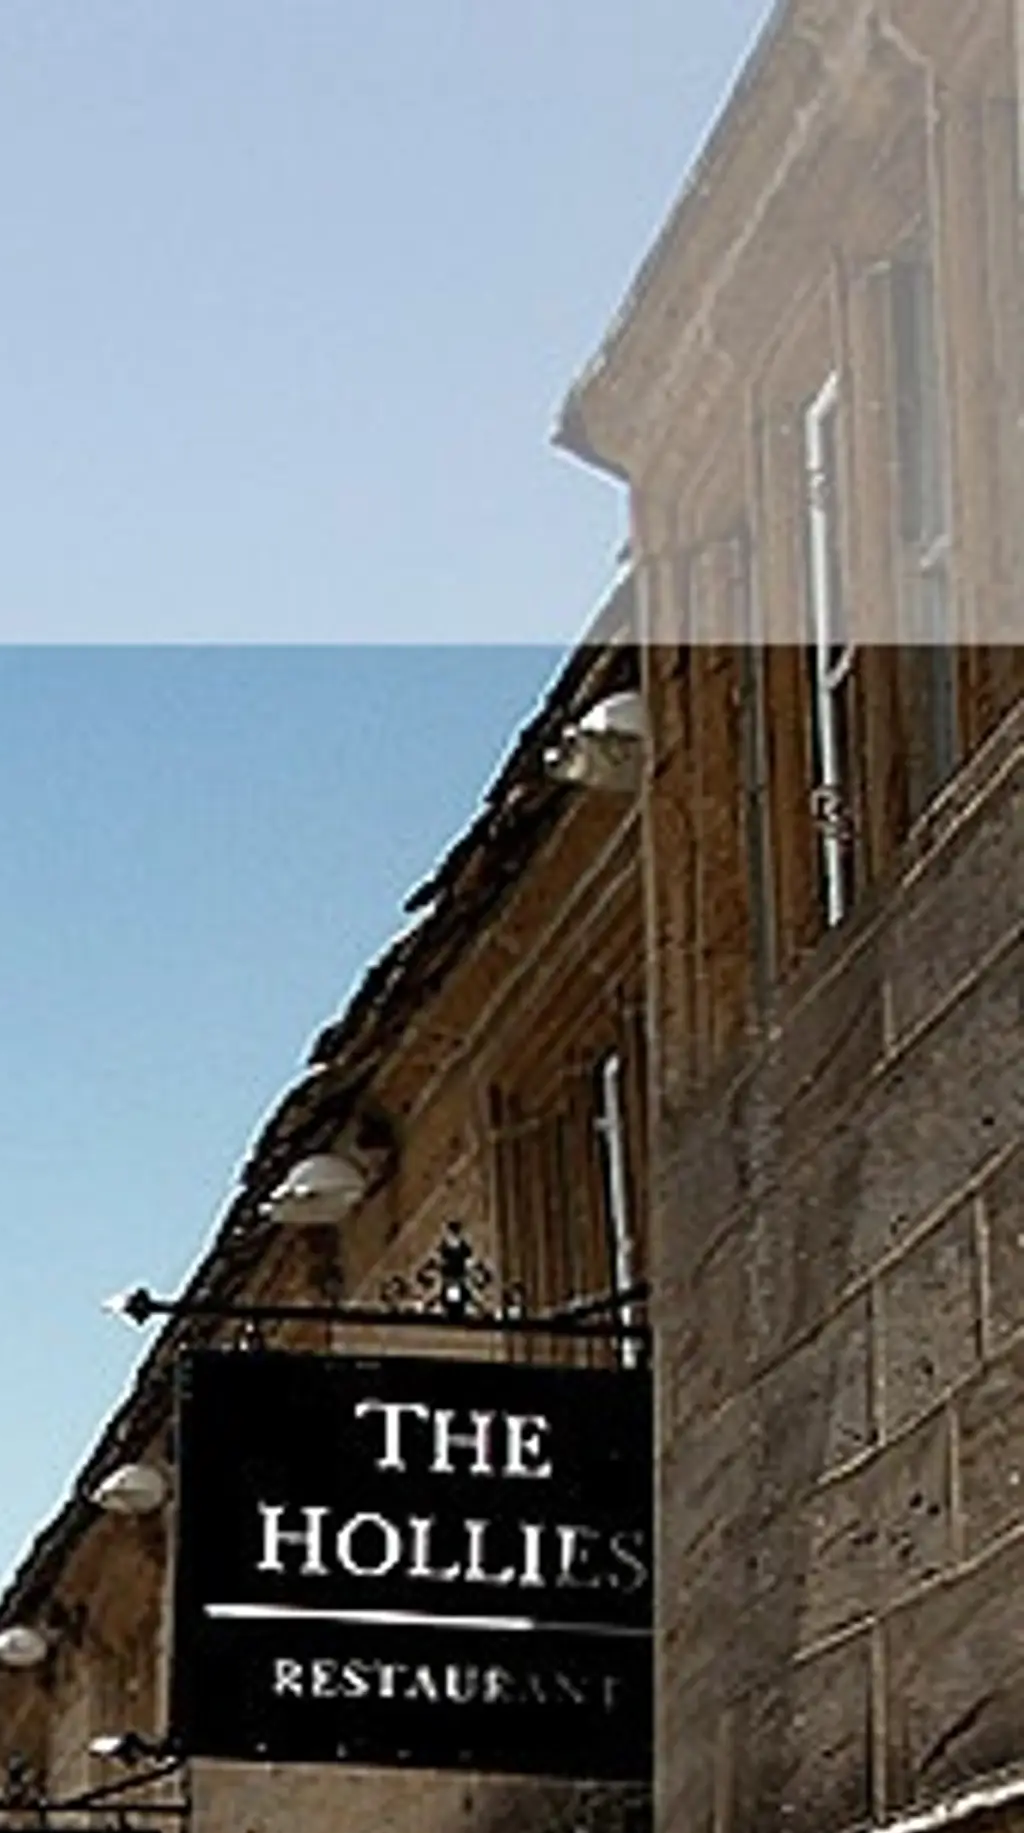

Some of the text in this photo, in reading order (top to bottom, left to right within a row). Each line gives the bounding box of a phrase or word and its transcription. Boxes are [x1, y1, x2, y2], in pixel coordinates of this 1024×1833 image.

[355, 1400, 552, 1479] THE
[256, 1500, 649, 1590] HOLLIES
[273, 1657, 619, 1707] RESTAURANT
